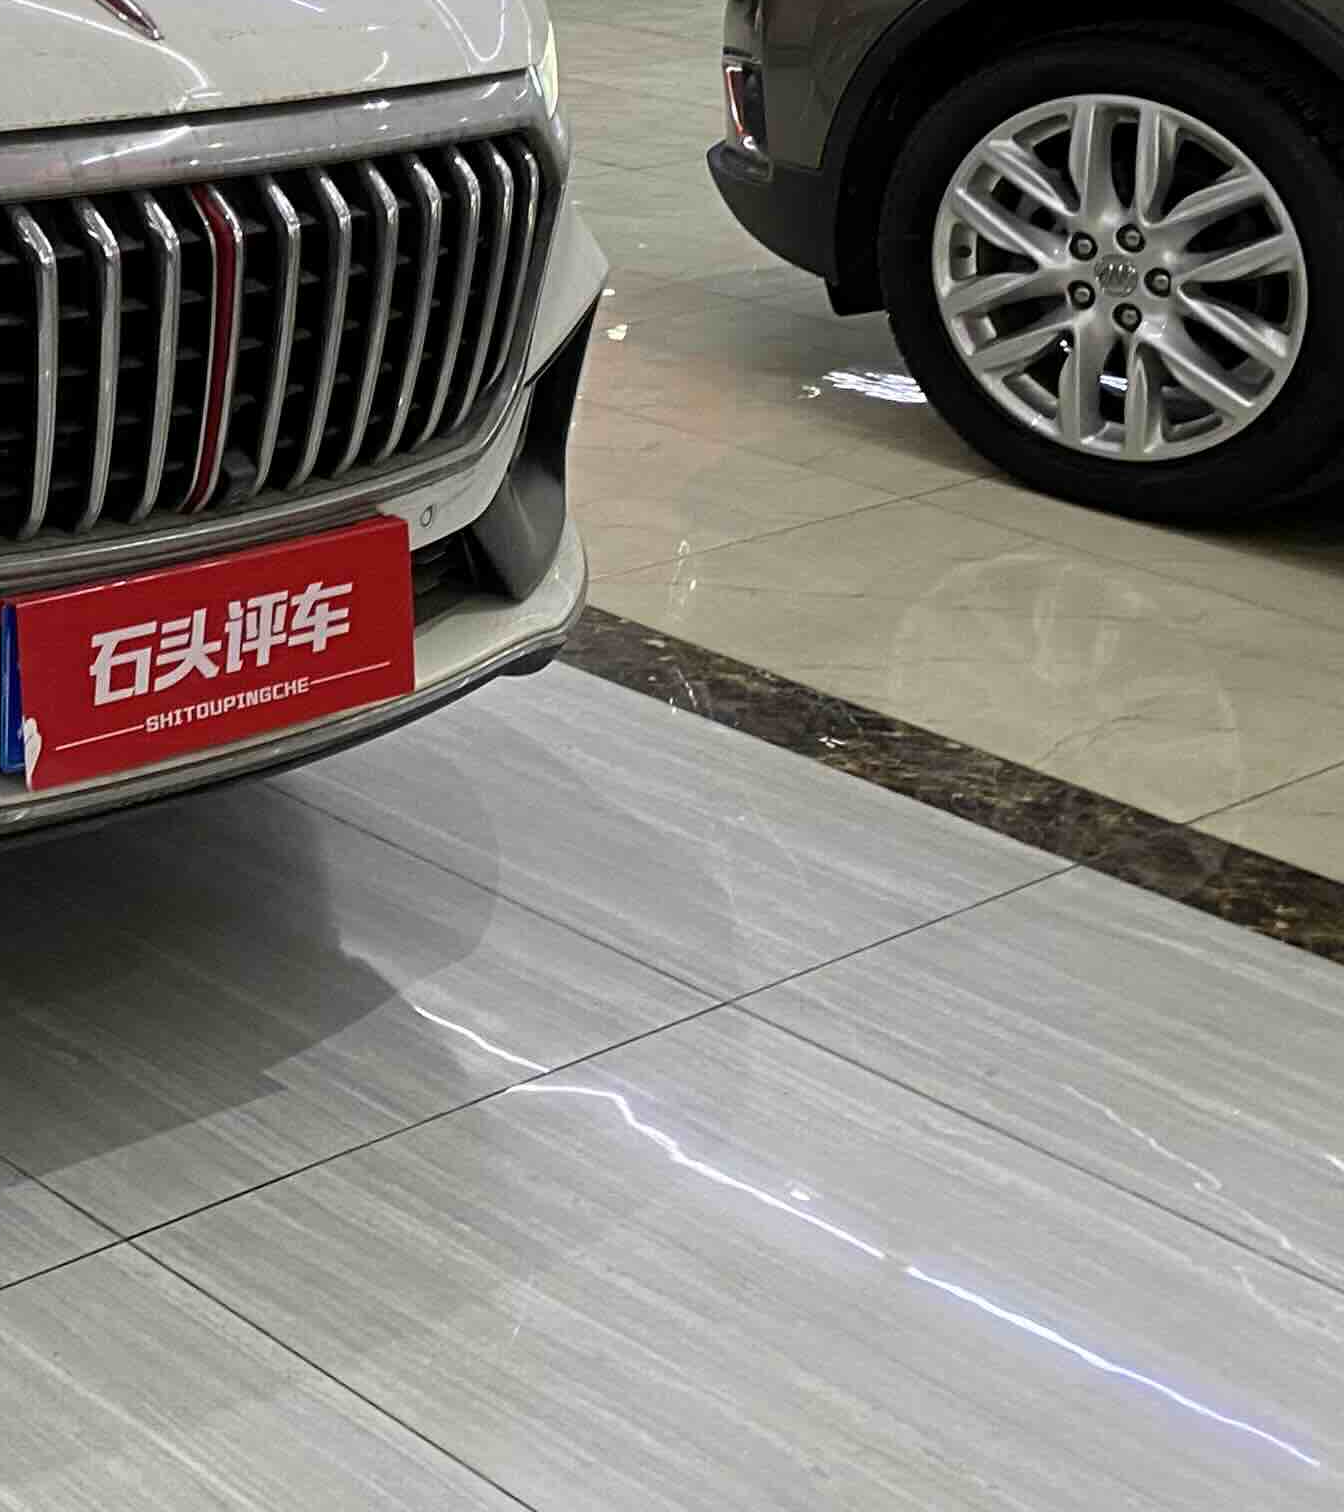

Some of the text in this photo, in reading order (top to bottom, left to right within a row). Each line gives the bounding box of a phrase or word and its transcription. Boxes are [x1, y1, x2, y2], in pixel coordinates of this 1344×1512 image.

[89, 581, 353, 707] 石头评车
[144, 676, 310, 733] SHITOUPINGCHE
